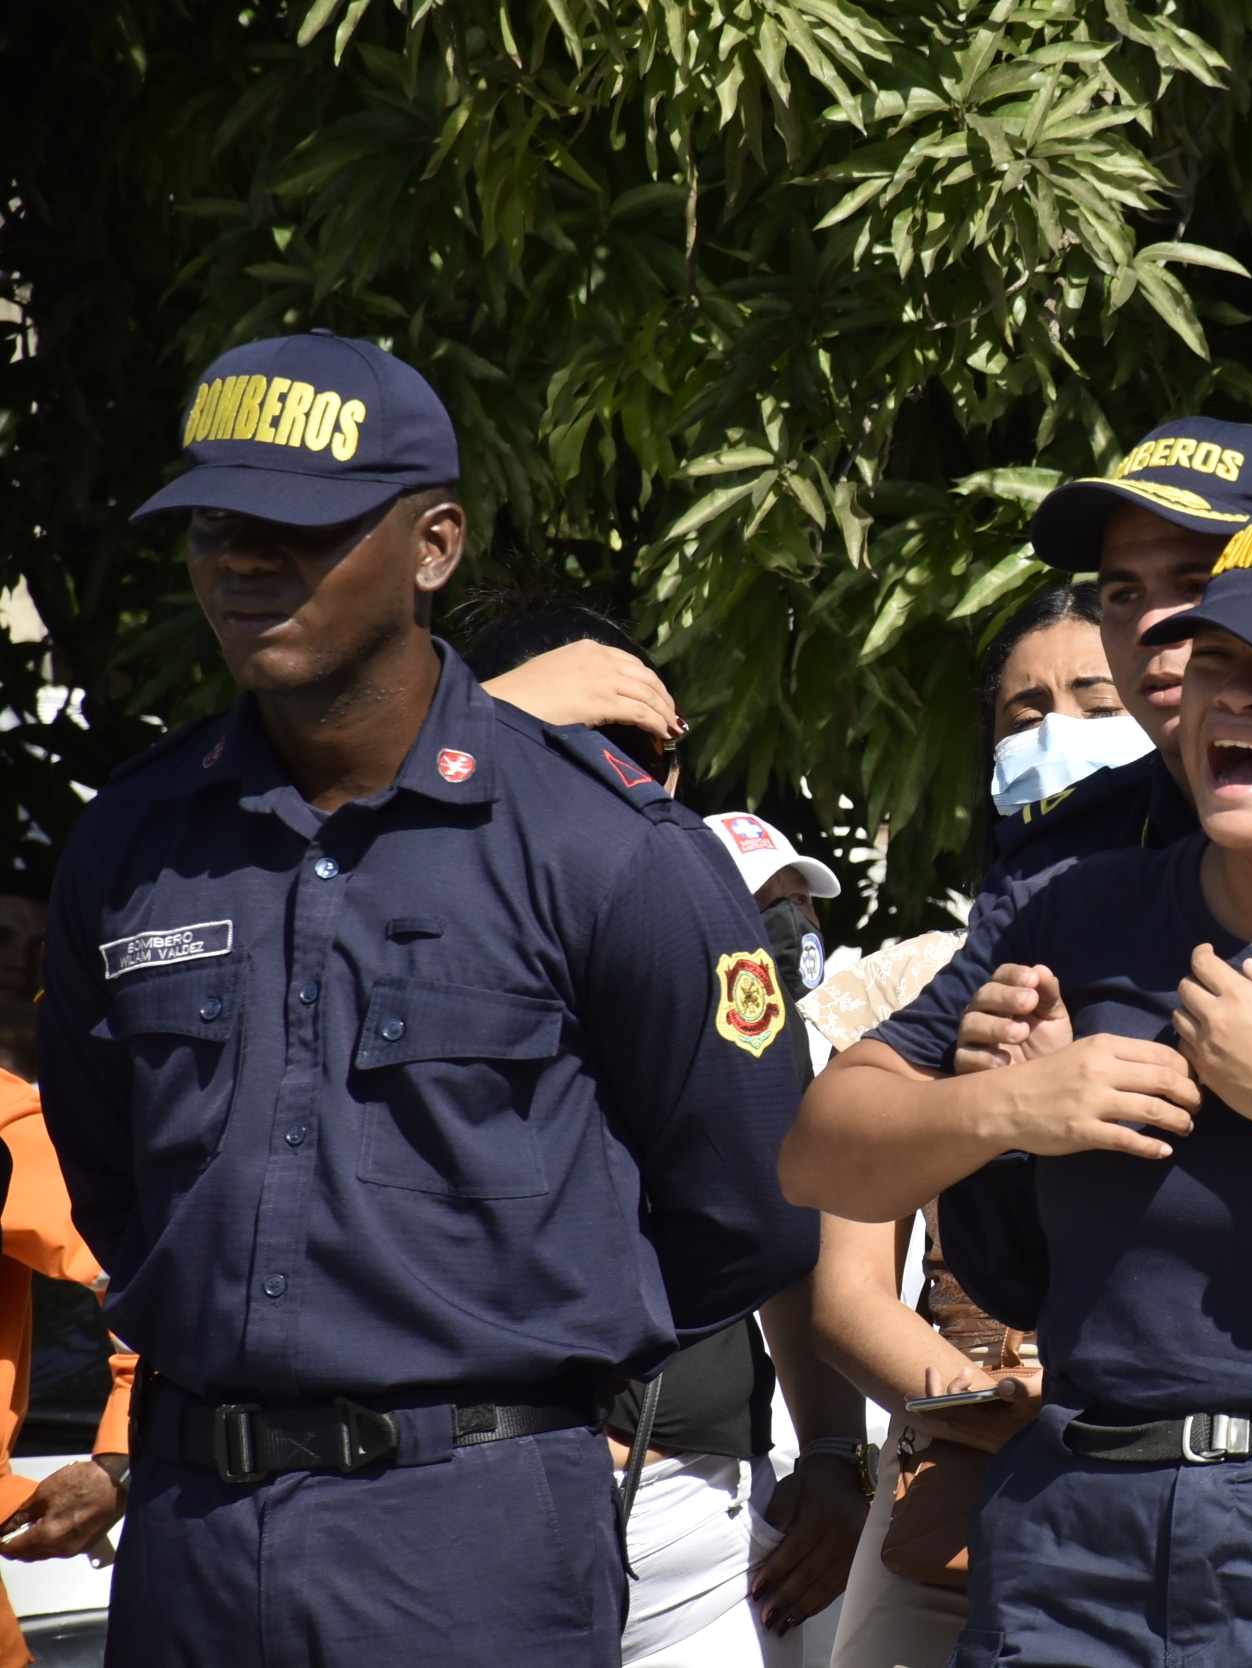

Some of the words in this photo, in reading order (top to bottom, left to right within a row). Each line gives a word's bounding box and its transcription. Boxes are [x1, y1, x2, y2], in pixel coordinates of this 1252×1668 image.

[183, 374, 367, 462] BOMBEROS
[1114, 437, 1245, 482] MBEROS
[128, 931, 193, 954] BOMBERO
[157, 941, 205, 960] VALDEZ
